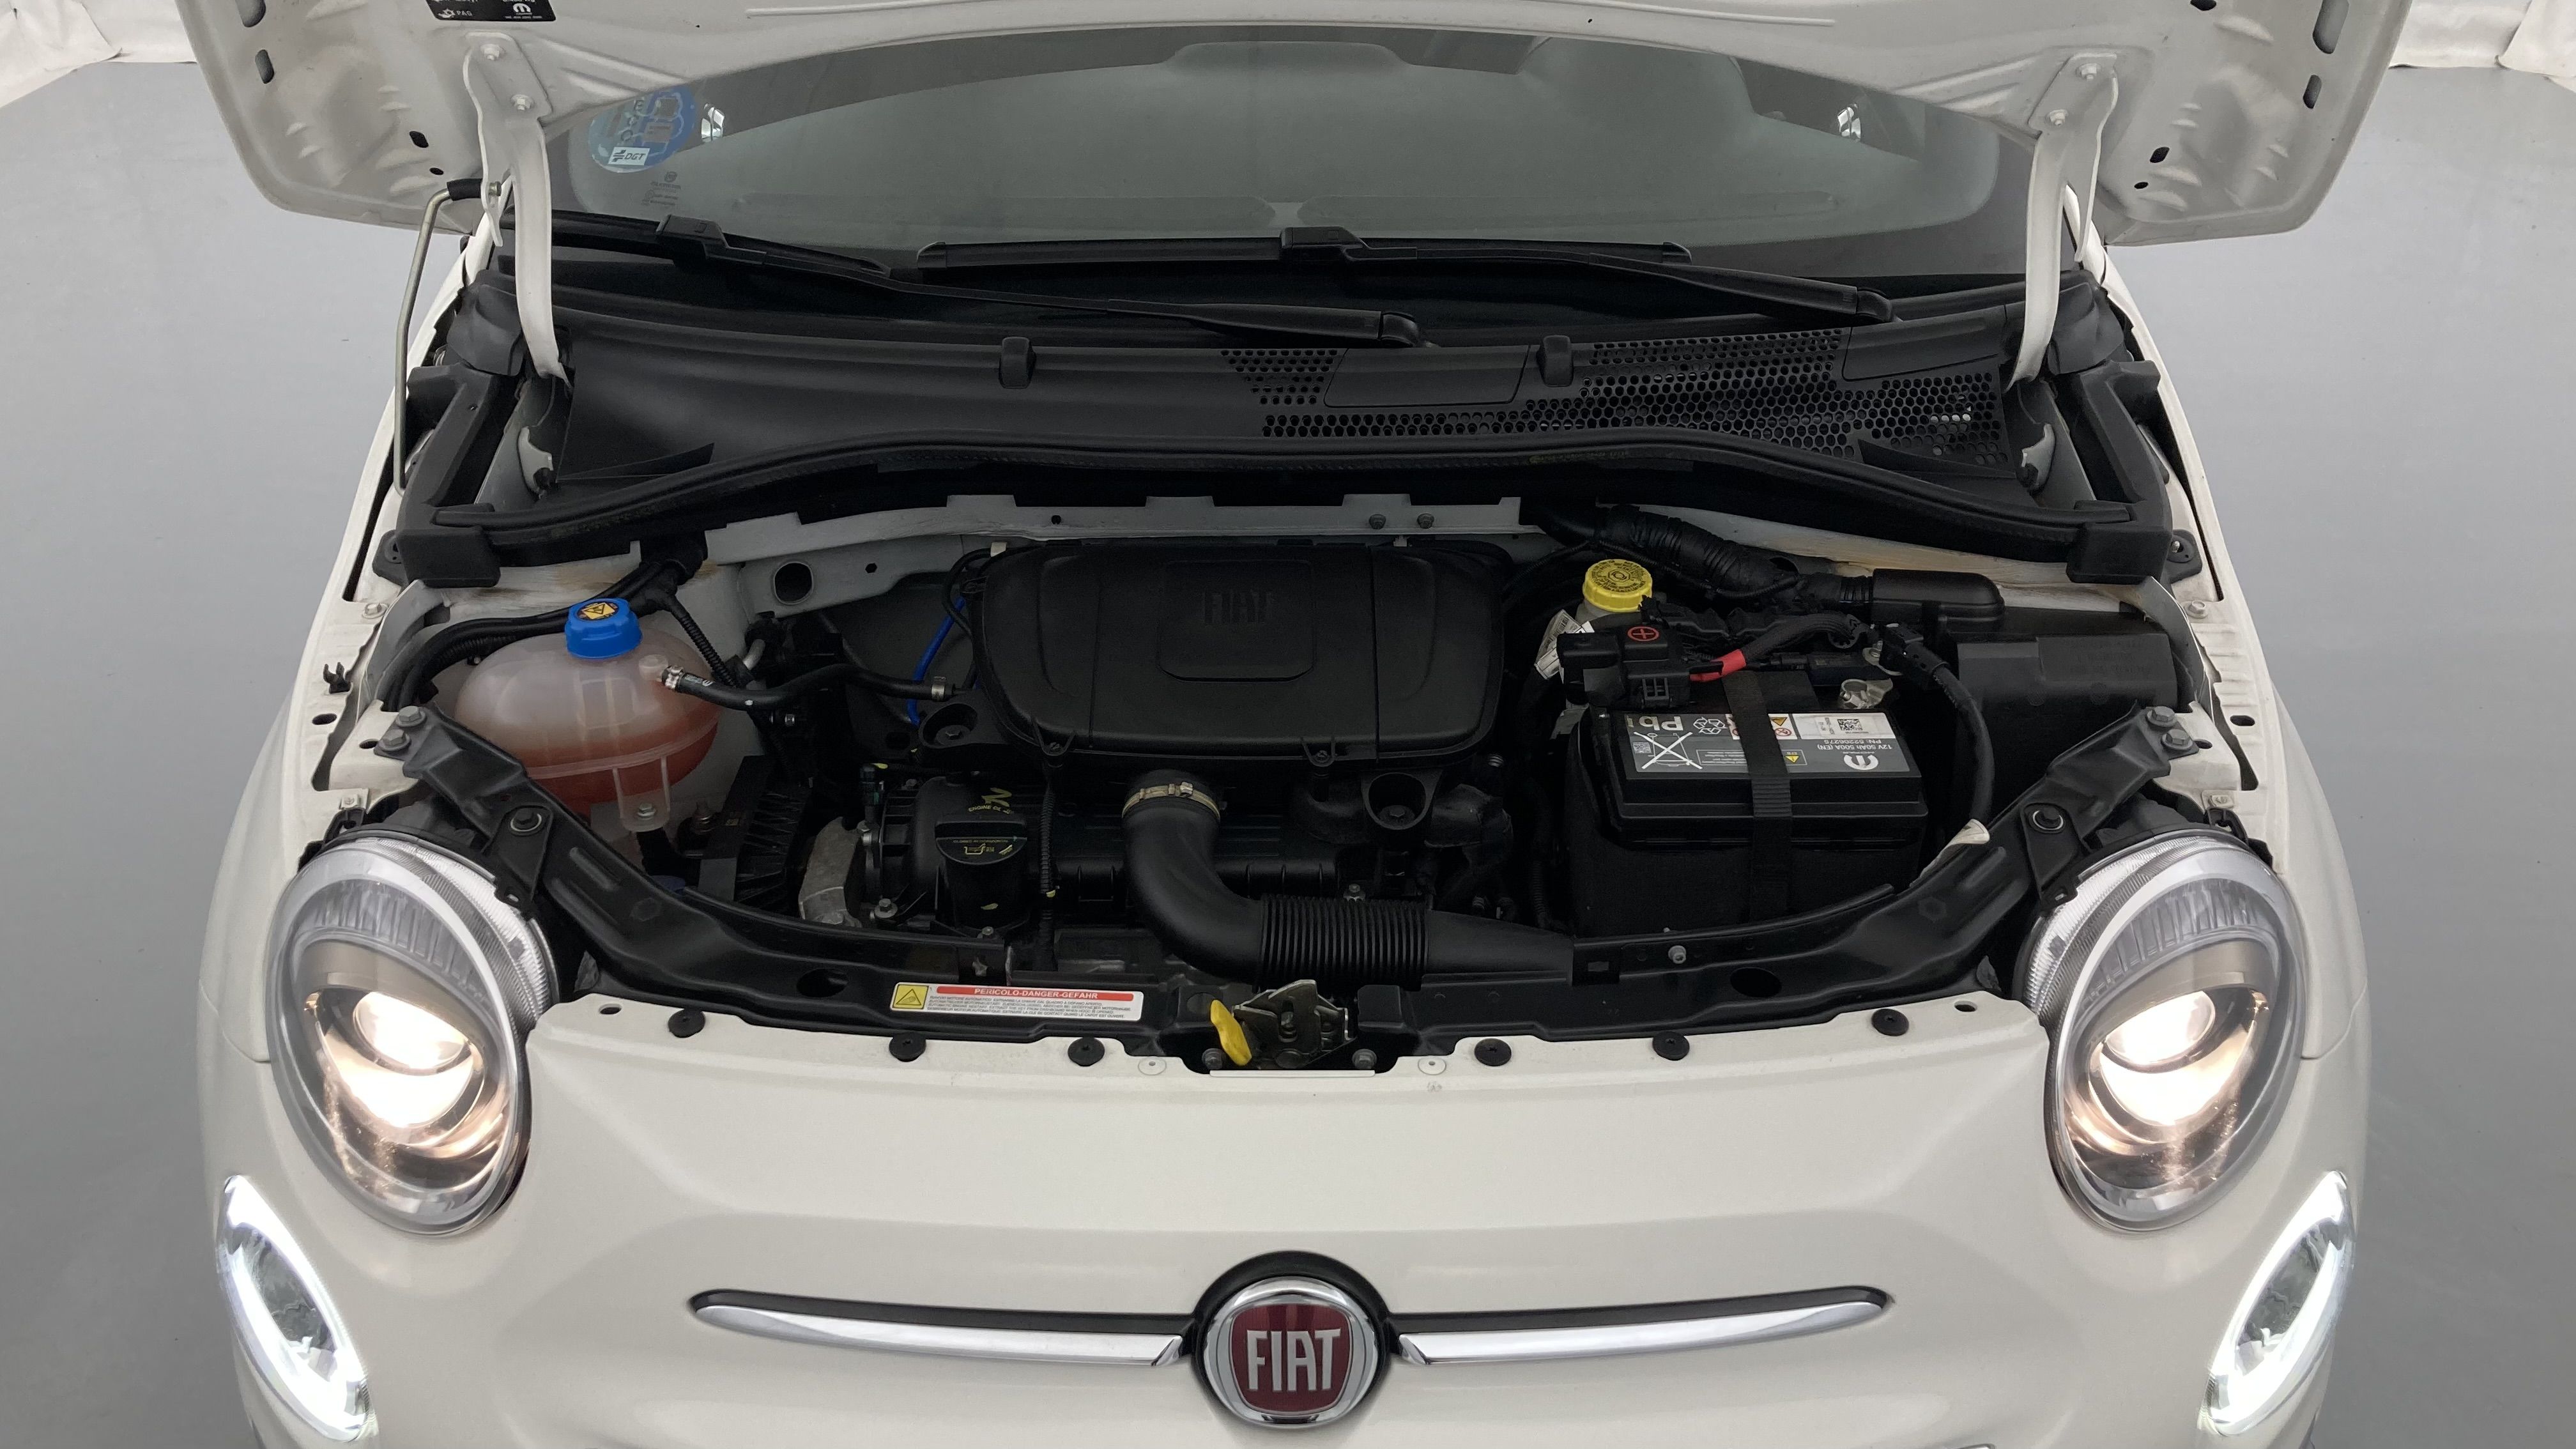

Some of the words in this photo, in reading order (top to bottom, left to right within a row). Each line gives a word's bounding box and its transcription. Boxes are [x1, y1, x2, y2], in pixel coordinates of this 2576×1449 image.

[1203, 590, 1271, 626] FIAT
[1638, 716, 1683, 732] Pb
[974, 988, 1098, 999] PERICOLO-DANGER-GEFAHR
[1246, 1328, 1341, 1392] FIAT
